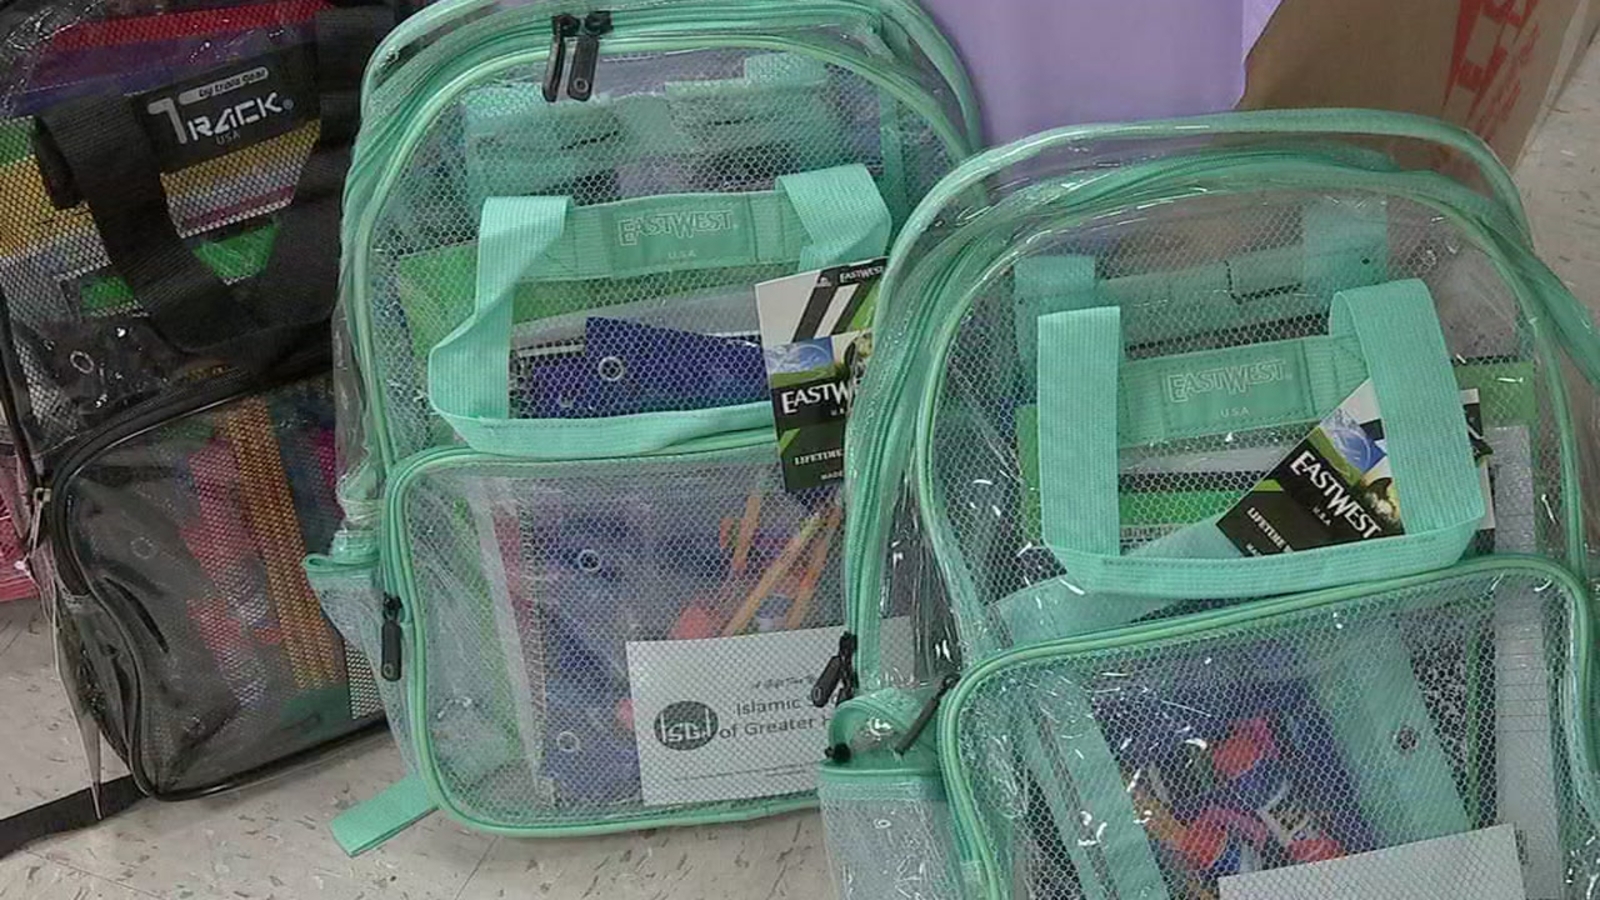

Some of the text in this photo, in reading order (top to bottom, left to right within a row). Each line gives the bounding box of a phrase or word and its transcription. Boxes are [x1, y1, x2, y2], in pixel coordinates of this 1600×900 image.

[214, 131, 240, 145] USA
[619, 208, 735, 246] EASTWEST
[668, 249, 697, 260] USA
[1167, 359, 1284, 403] EASTWEST
[1220, 406, 1251, 418] USA
[1289, 450, 1382, 539] EASTWEST
[734, 700, 802, 716] Islamic
[718, 722, 741, 740] of
[743, 716, 814, 736] Greater
